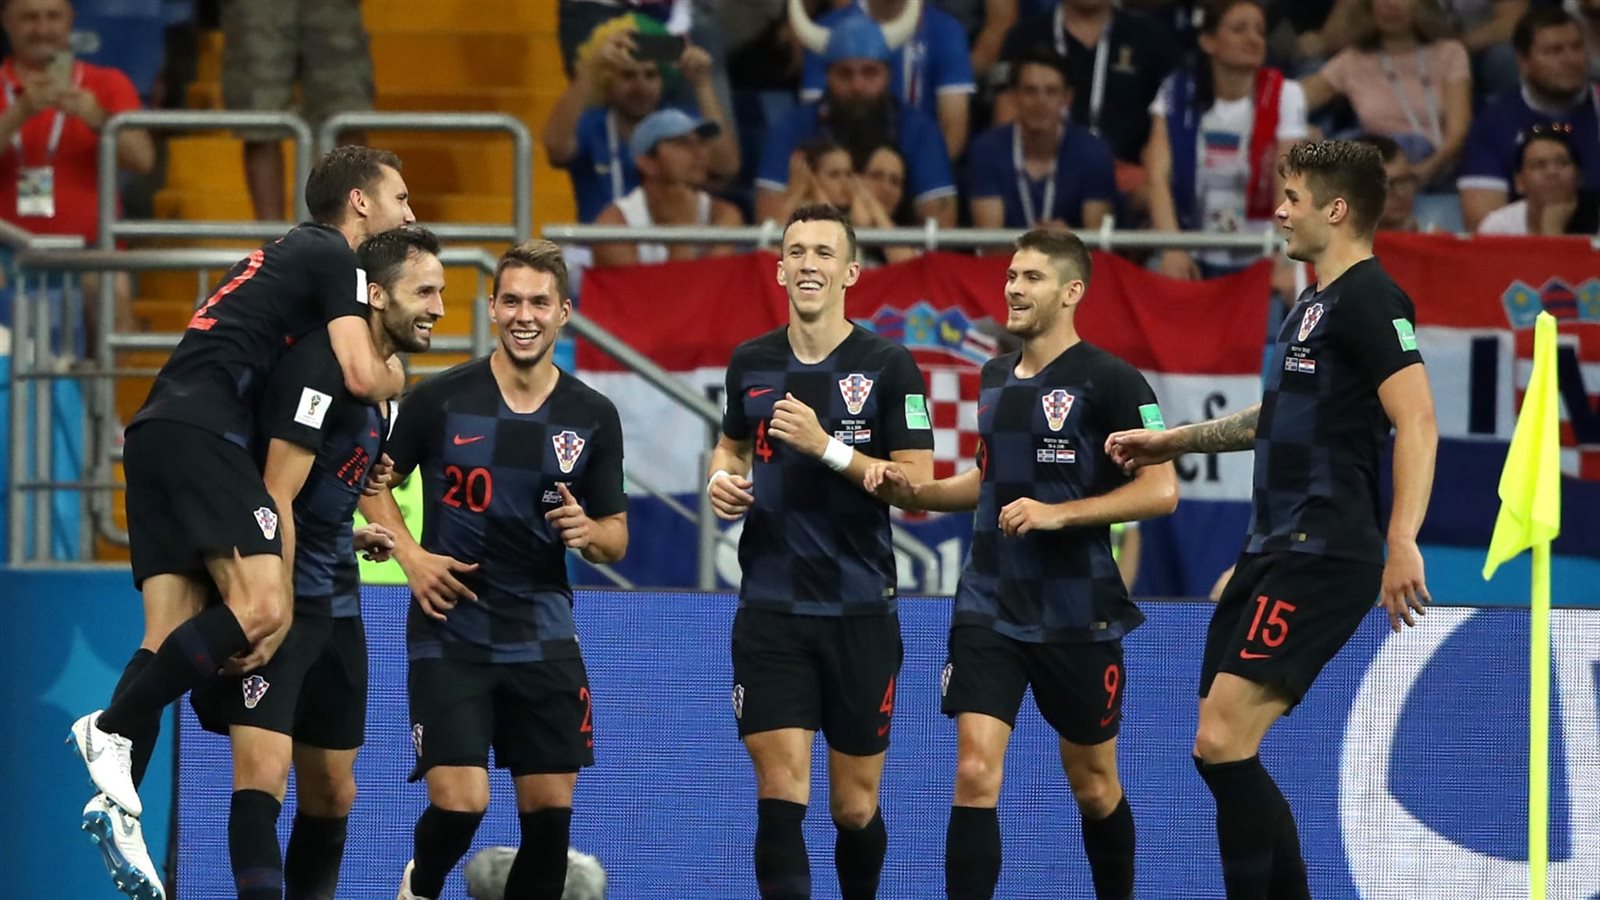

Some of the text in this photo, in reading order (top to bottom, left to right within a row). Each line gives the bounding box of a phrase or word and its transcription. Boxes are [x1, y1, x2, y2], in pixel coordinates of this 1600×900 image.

[187, 249, 264, 331] 2
[755, 417, 774, 464] 4
[441, 465, 493, 513] 20
[1246, 595, 1297, 647] 15
[879, 673, 894, 717] 4
[1104, 664, 1119, 709] 9
